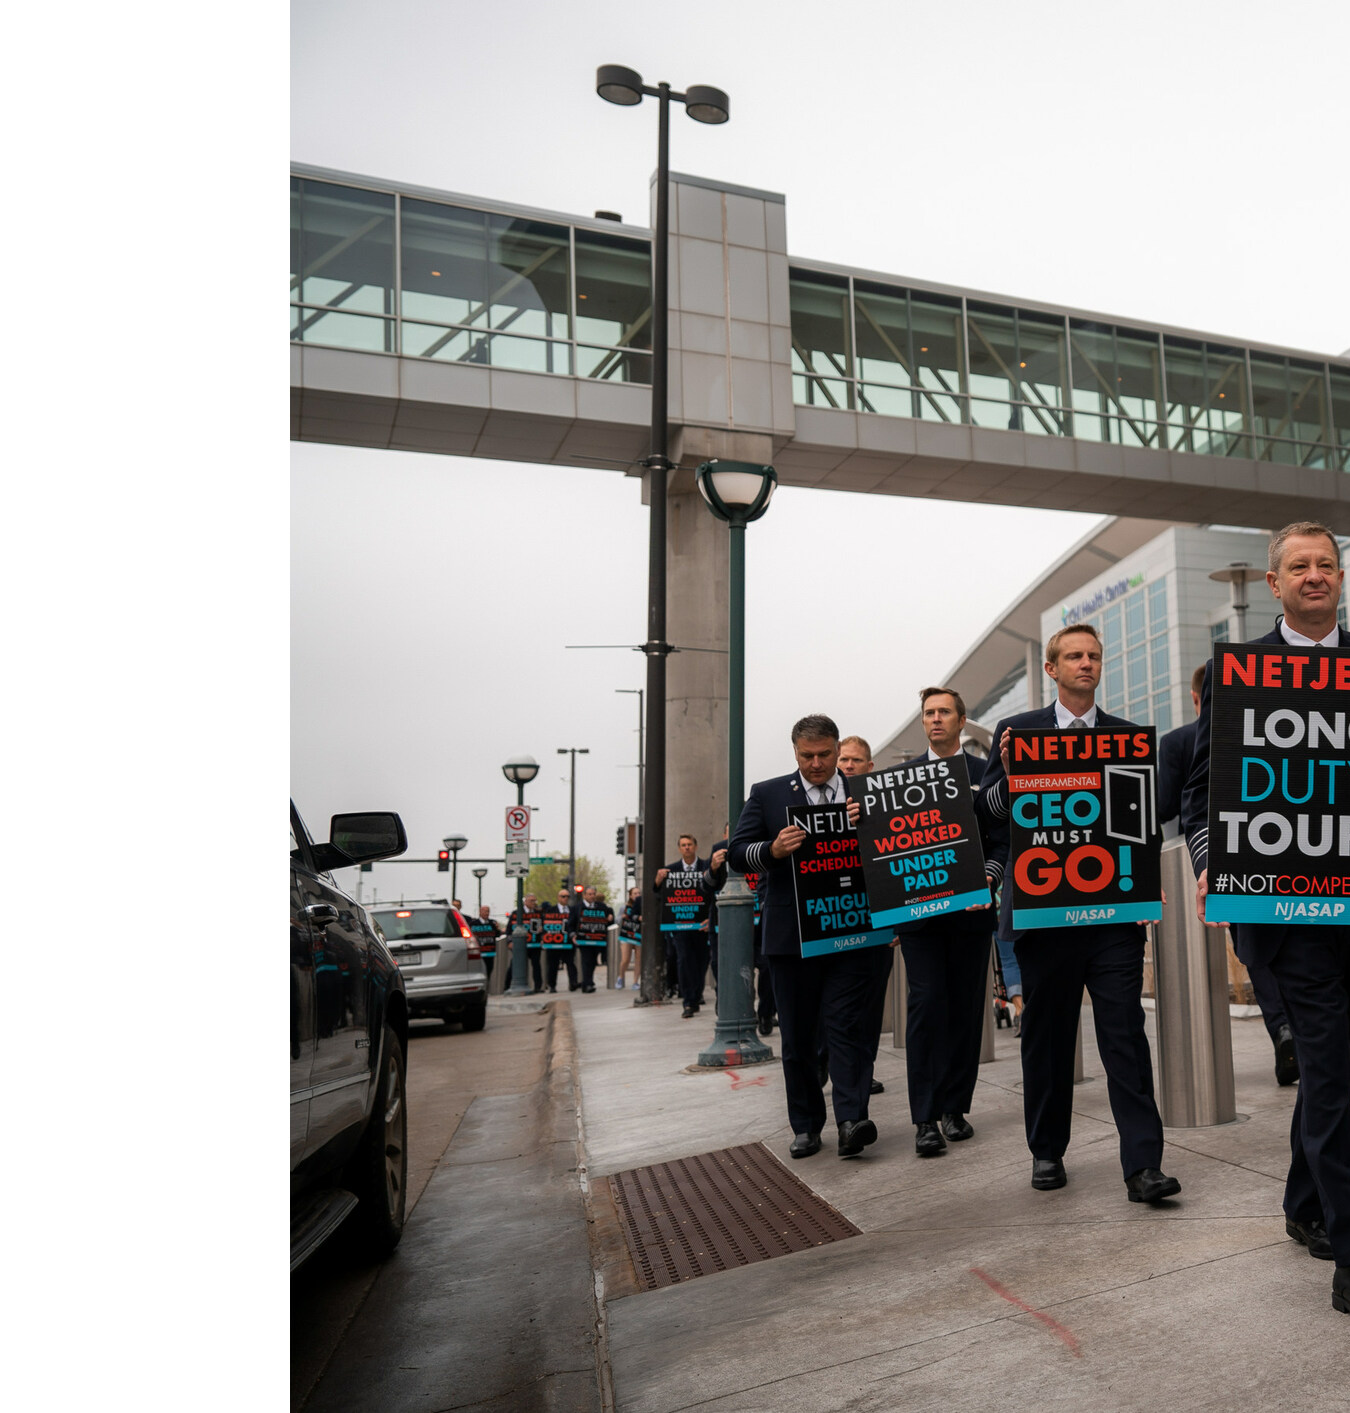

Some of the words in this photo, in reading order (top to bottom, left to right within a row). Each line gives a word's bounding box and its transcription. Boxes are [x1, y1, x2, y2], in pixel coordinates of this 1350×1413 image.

[1014, 733, 1150, 761] NETJETS
[866, 761, 949, 792] NETJETS
[1014, 776, 1098, 788] TEMPERAMENTAL
[864, 778, 959, 816] PILOTS
[889, 808, 943, 832] OVER
[1012, 791, 1100, 829] CEO
[793, 810, 857, 834] NETJE
[816, 838, 858, 855] SLOPP
[874, 822, 962, 854] WORKED
[1032, 829, 1093, 846] MUST
[800, 855, 862, 874] SCHEDUL
[889, 849, 958, 876] UNDER
[1014, 845, 1134, 896] GO!
[903, 869, 949, 892] PAID
[904, 890, 955, 905] #NOTCOMPETITIVE
[671, 905, 699, 913] UNDER
[910, 900, 950, 918] NJASAP
[1065, 908, 1116, 924] NJASAP
[1275, 901, 1345, 921] NJASAP
[834, 935, 867, 950] NJASAP
